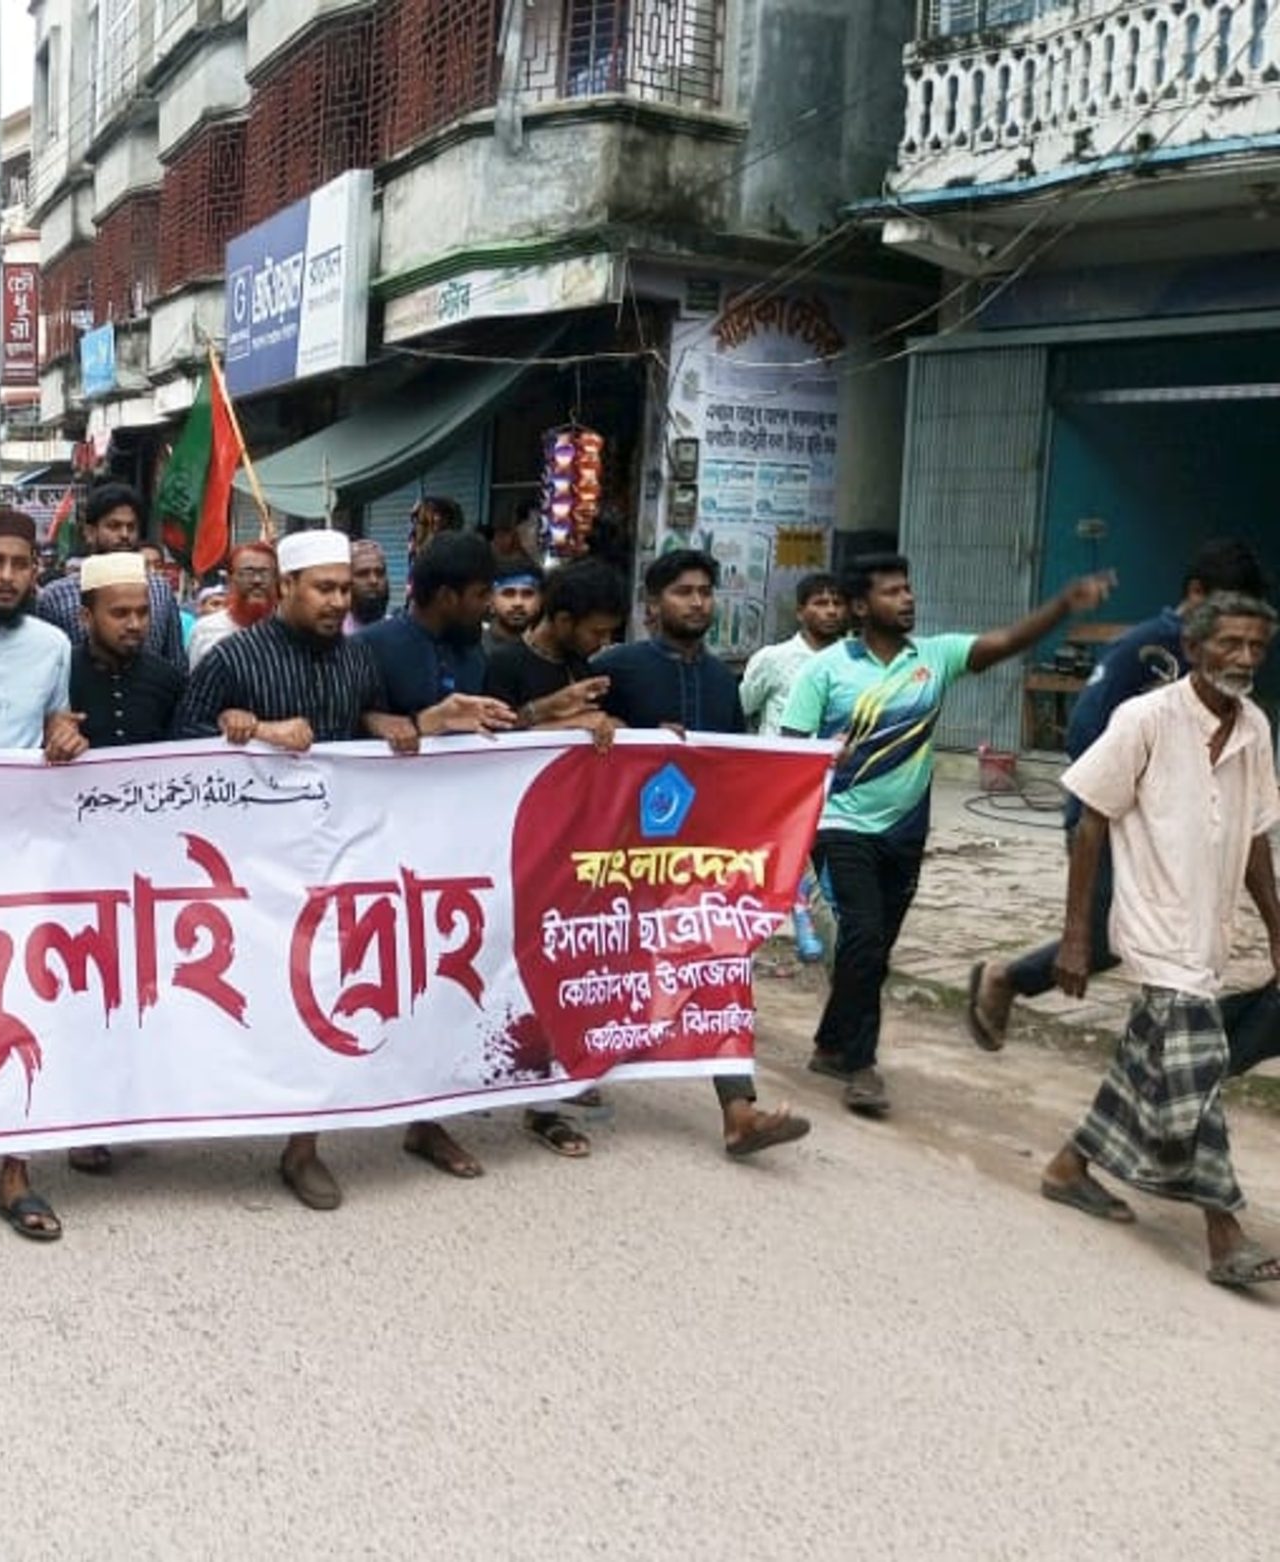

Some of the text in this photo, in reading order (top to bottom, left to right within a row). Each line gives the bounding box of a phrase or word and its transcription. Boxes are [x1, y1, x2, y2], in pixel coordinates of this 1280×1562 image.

[571, 847, 769, 891] বাংলাদেশ
[289, 864, 495, 1057] দ্রোহ
[541, 891, 786, 963] ইসলামী ছাত্রশিবি
